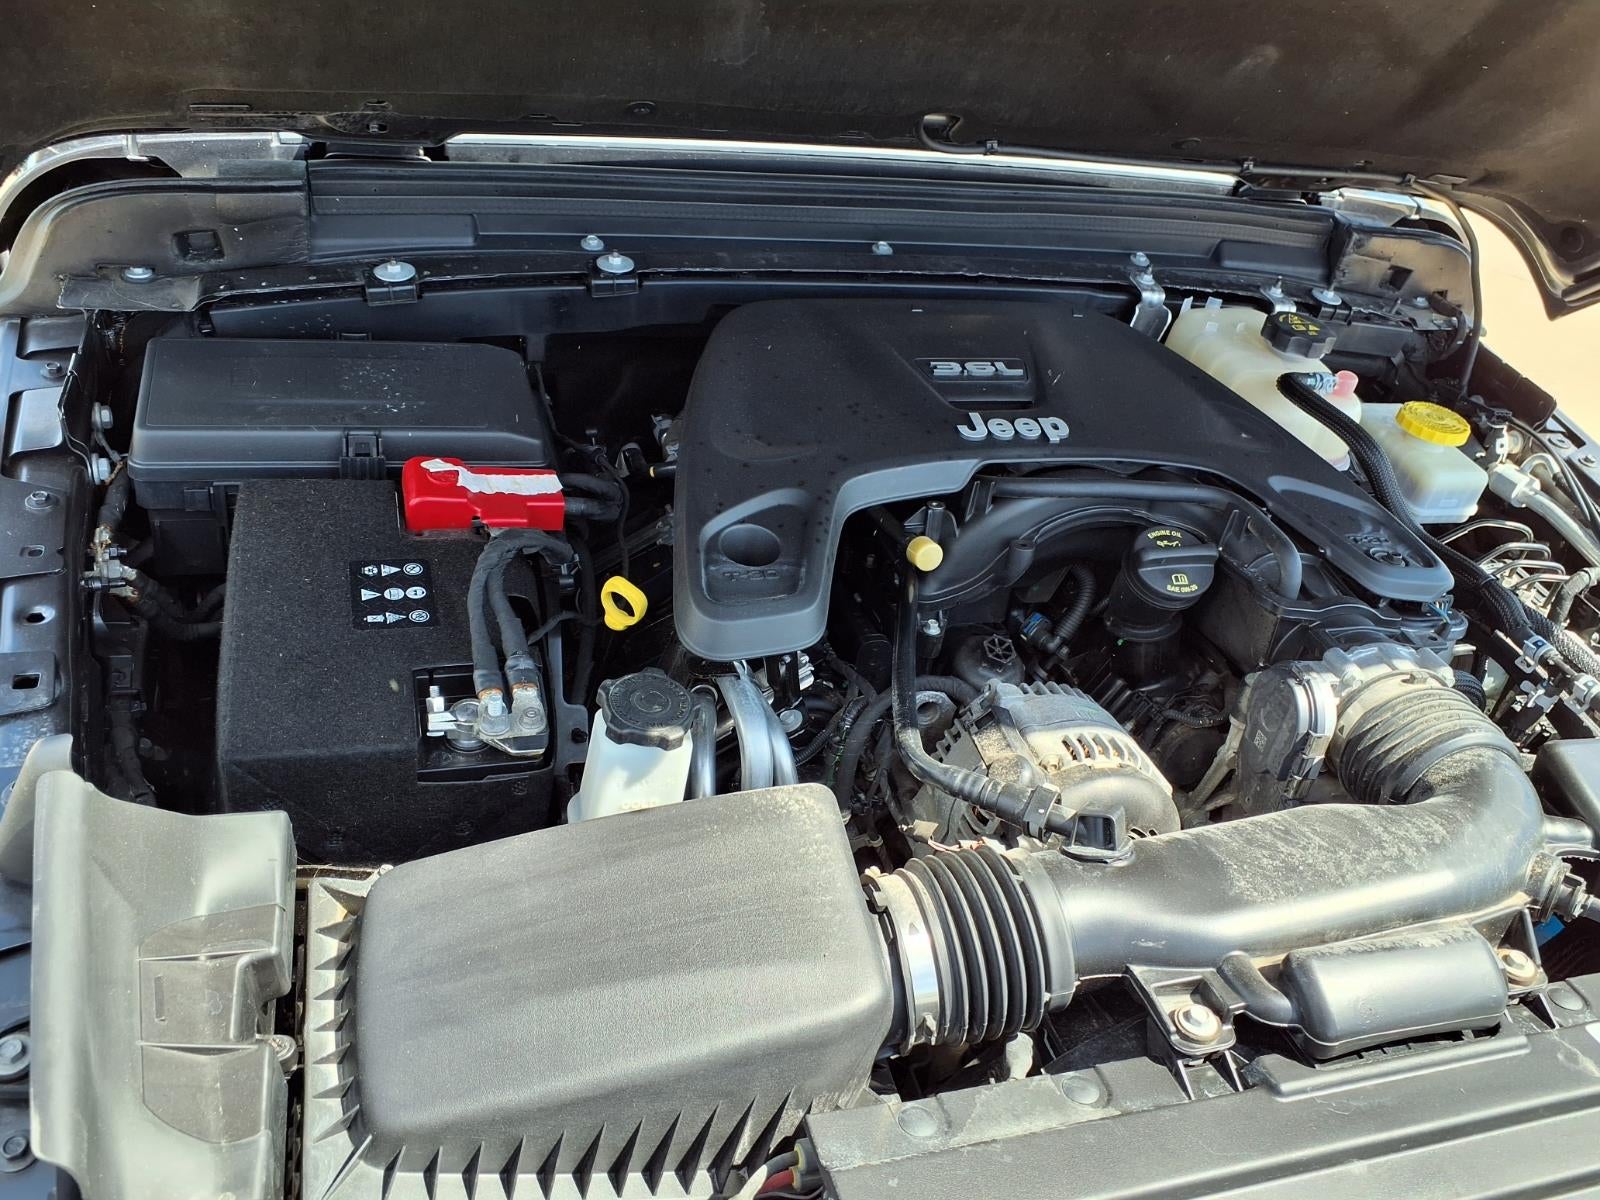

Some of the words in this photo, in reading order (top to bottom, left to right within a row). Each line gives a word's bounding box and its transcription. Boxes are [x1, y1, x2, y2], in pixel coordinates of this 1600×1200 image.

[930, 361, 1024, 377] 3.6L
[956, 412, 1070, 443] Jeep
[1147, 529, 1171, 539] ENGINE
[1171, 530, 1183, 539] OIL
[1166, 584, 1181, 593] SAE
